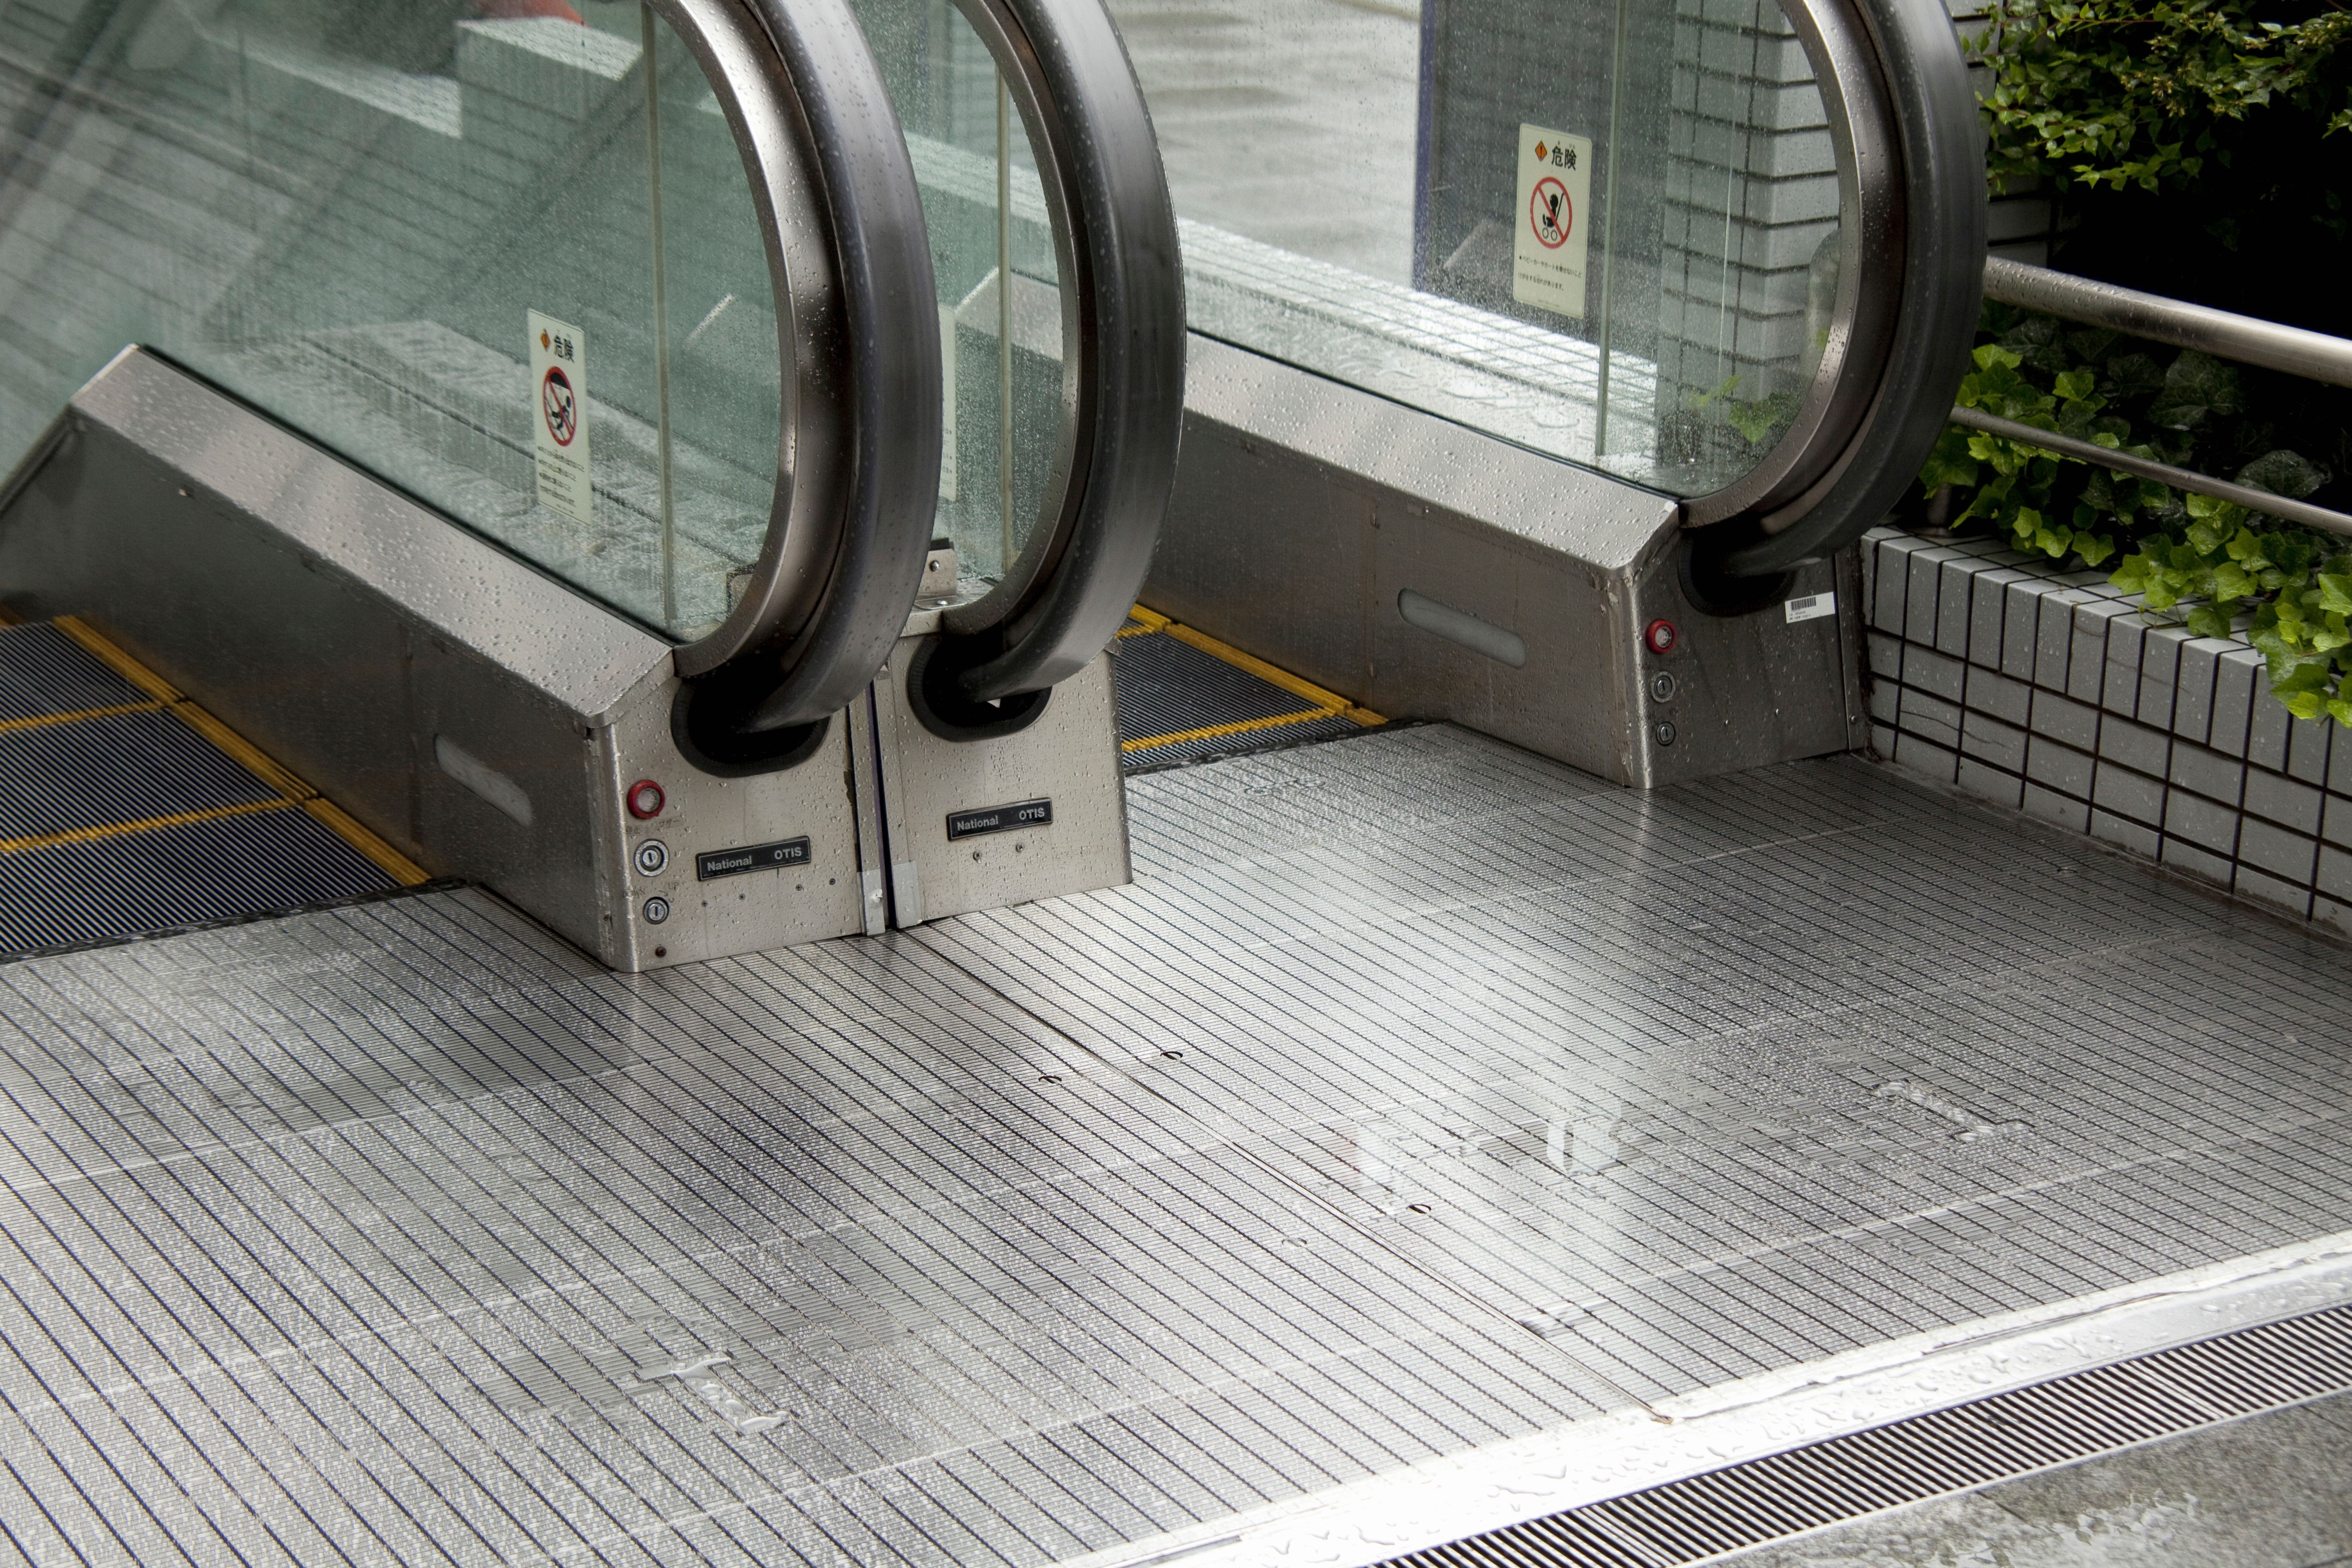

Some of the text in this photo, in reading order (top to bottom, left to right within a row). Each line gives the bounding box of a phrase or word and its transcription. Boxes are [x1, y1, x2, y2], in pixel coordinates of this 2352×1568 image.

[1551, 145, 1577, 171] 危険
[554, 334, 575, 363] 危険
[957, 807, 1045, 831] National OTIS
[707, 846, 802, 872] National OTIS
